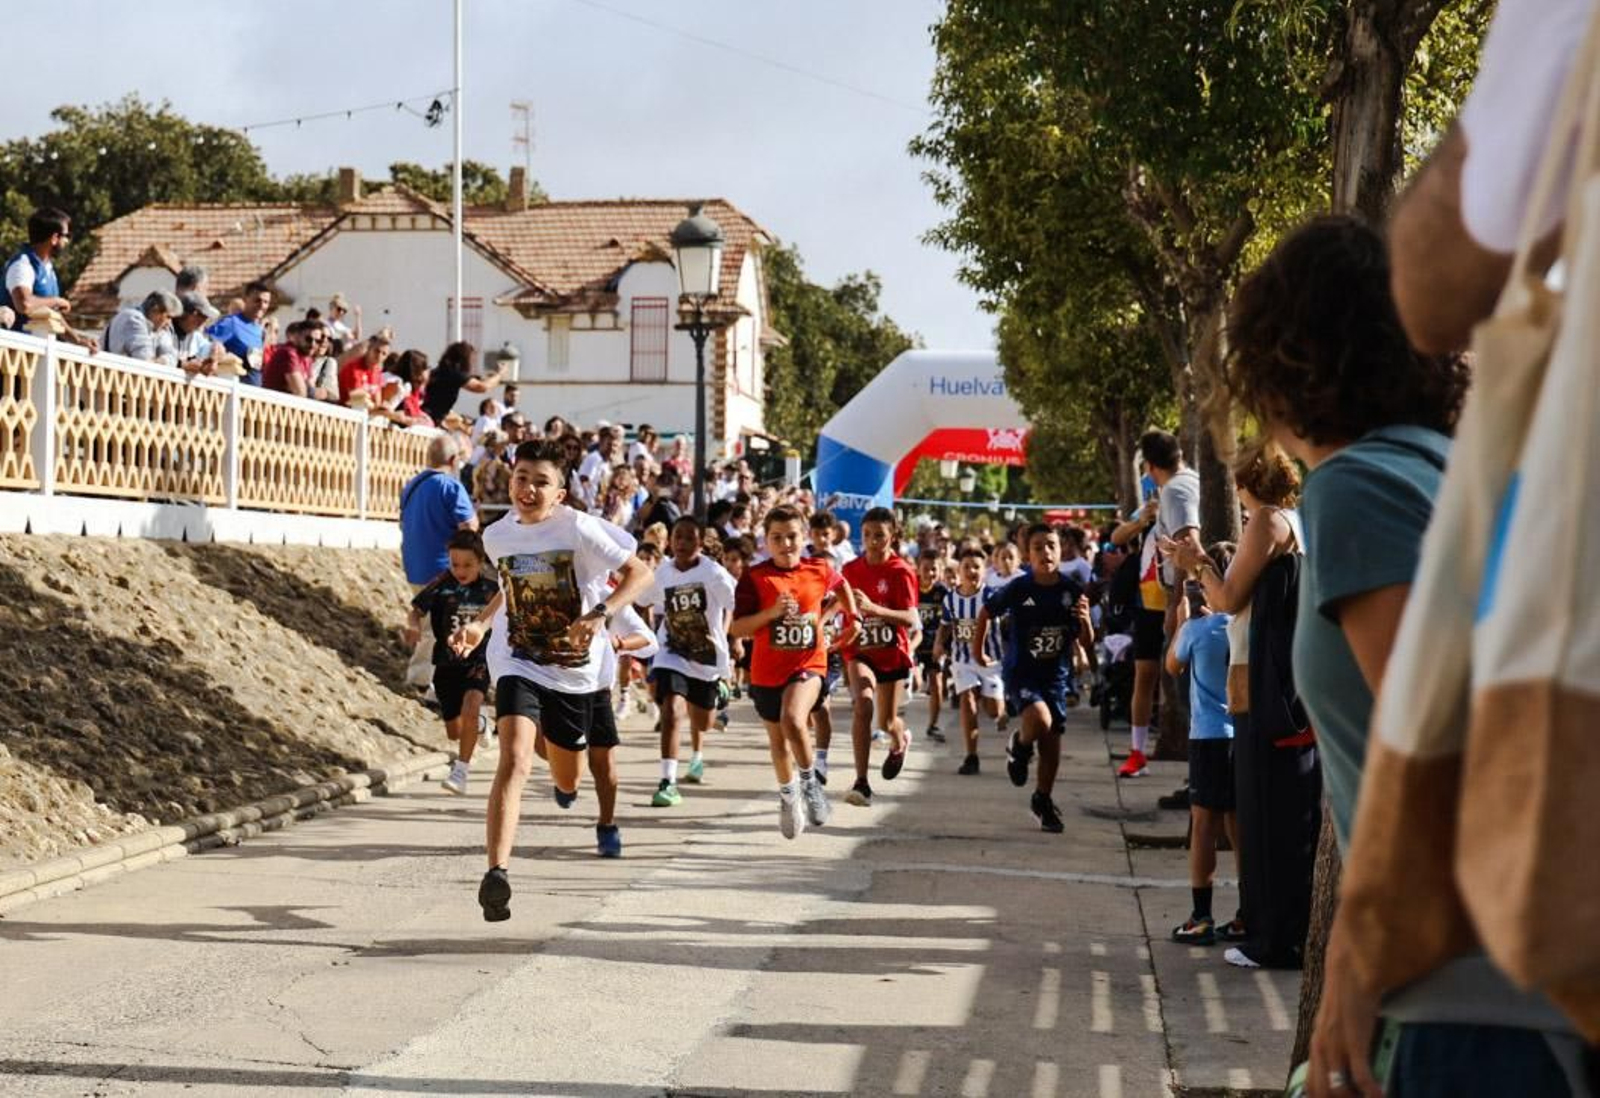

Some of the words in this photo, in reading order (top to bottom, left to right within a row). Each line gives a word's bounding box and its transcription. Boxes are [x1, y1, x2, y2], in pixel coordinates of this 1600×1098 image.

[930, 376, 1003, 395] Huelva
[671, 592, 701, 612] 194
[775, 625, 813, 645] 309
[859, 626, 893, 645] 310
